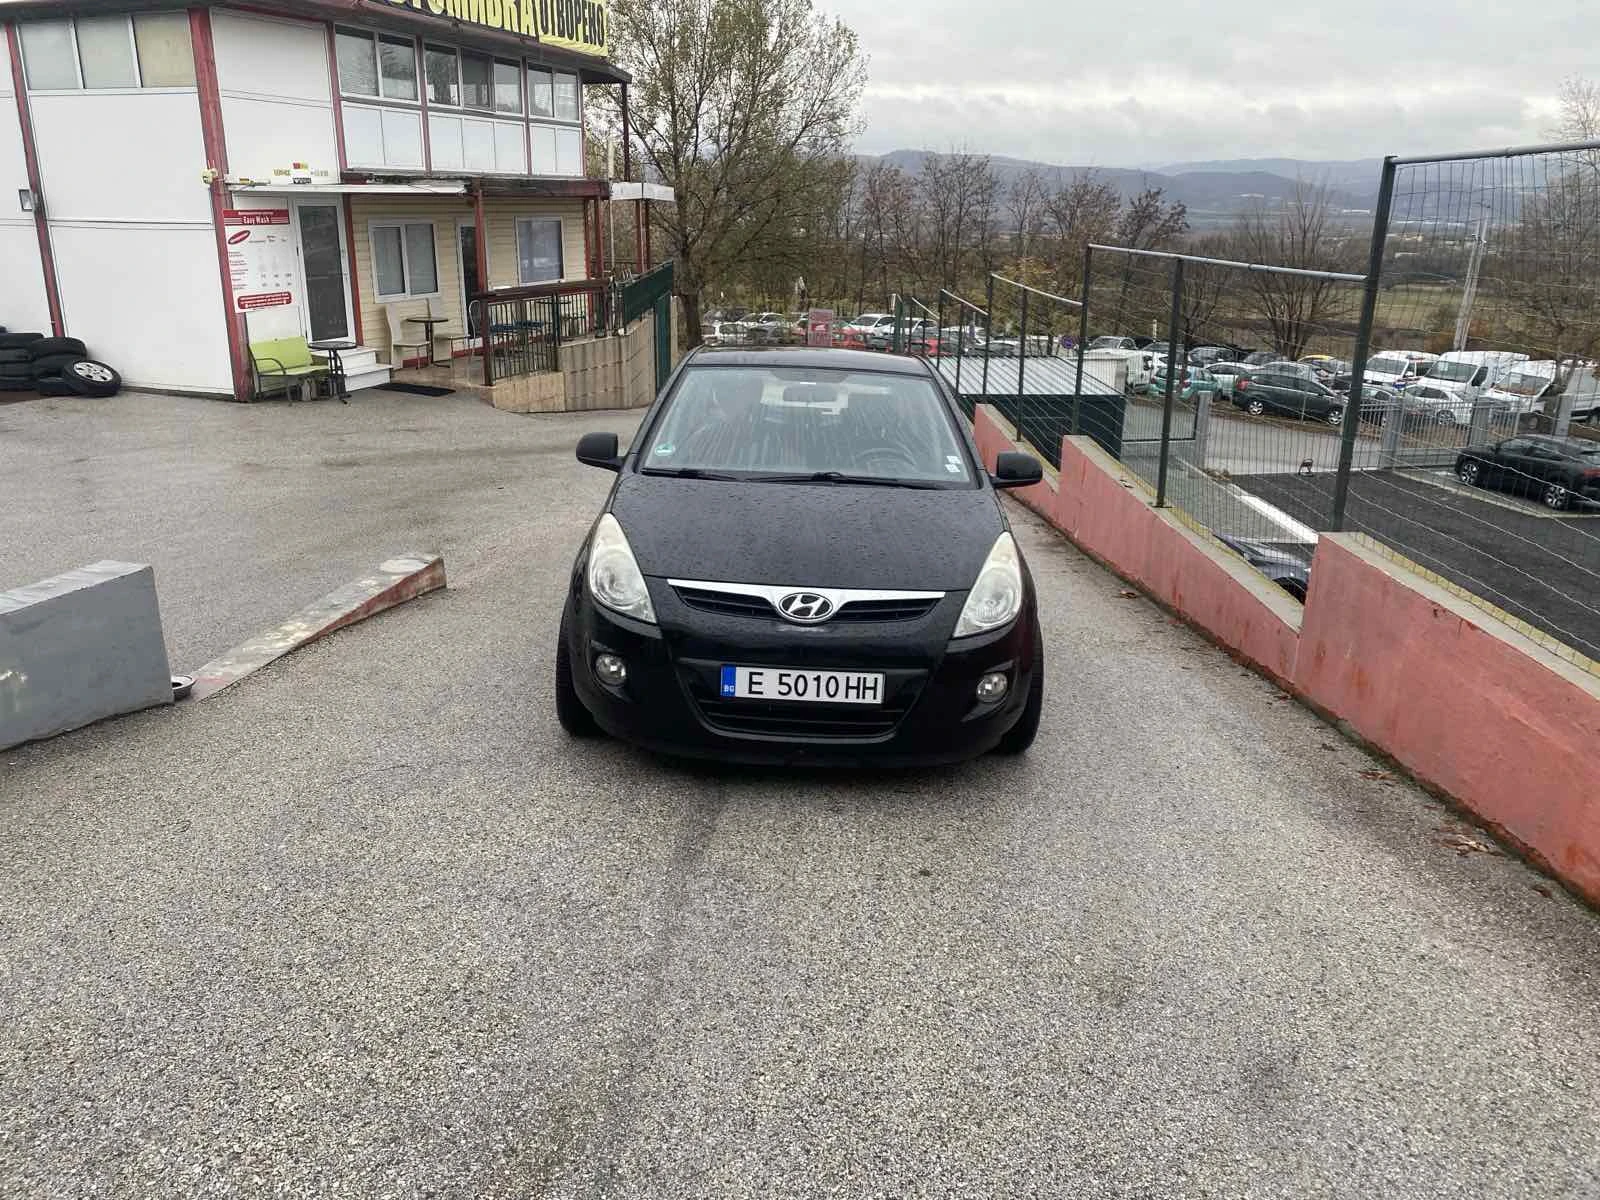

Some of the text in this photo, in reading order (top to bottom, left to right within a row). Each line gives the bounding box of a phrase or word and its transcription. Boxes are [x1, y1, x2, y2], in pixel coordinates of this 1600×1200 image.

[540, 0, 605, 48] ОТВОРЕНО
[256, 214, 271, 224] Wash
[748, 671, 764, 695] E
